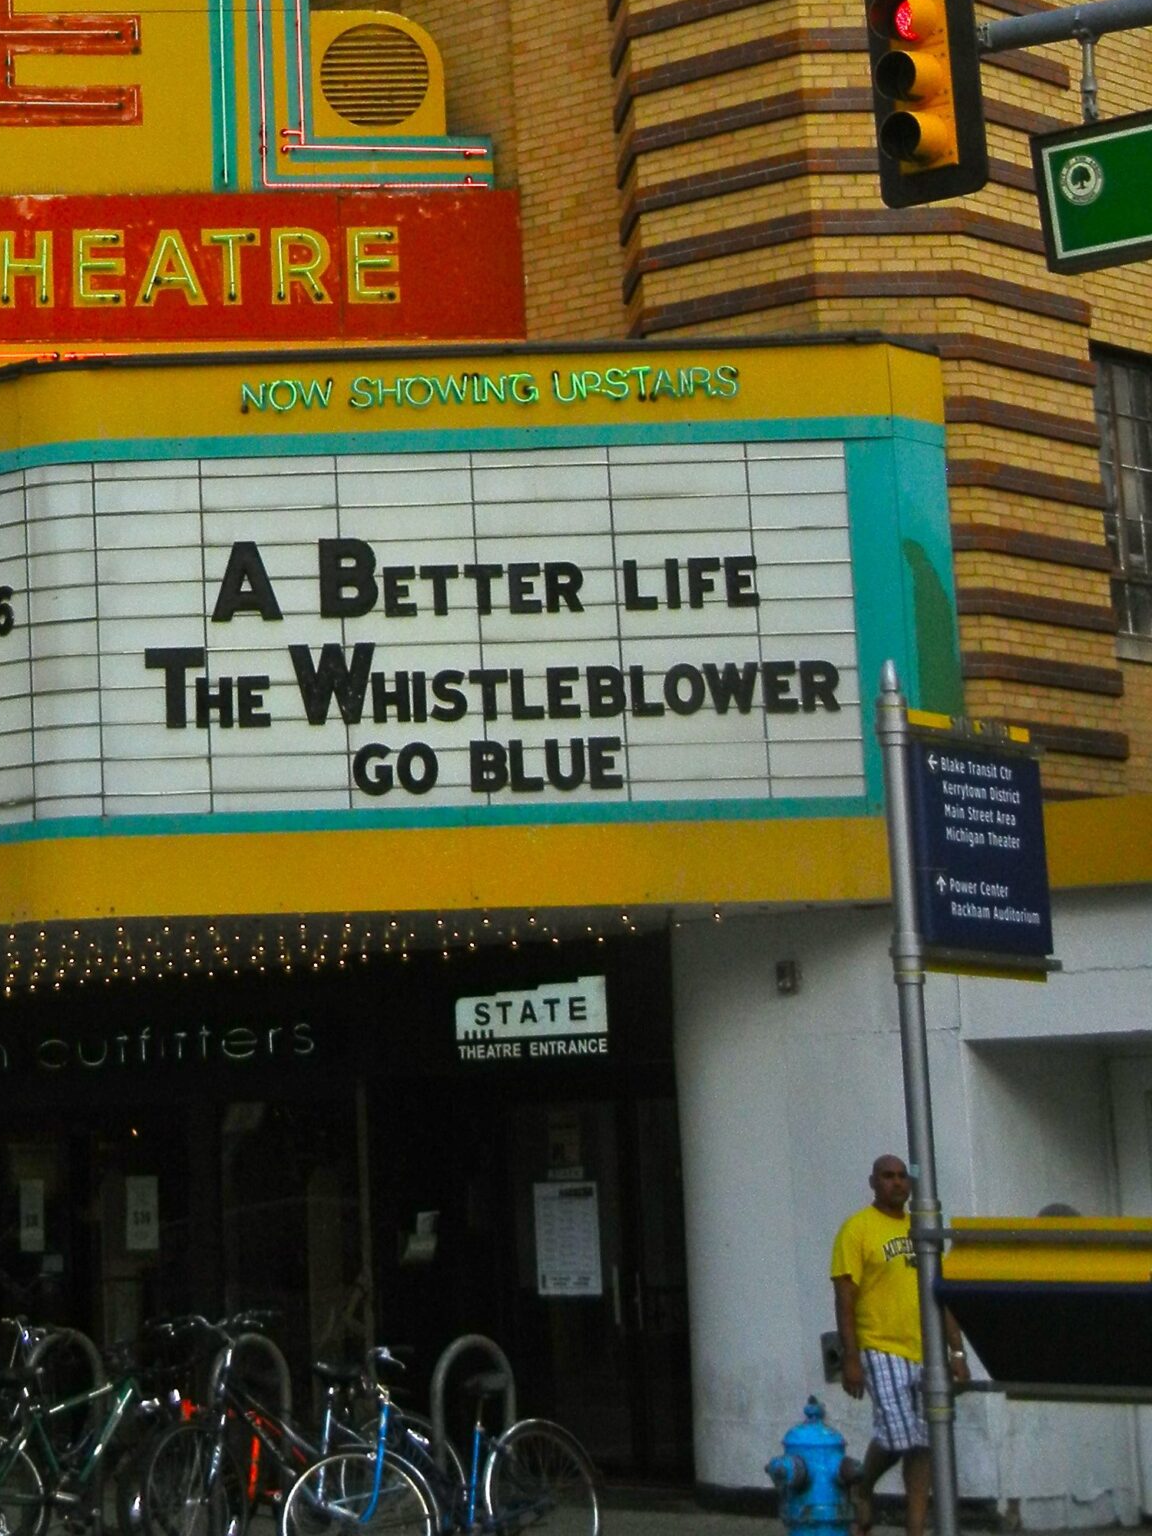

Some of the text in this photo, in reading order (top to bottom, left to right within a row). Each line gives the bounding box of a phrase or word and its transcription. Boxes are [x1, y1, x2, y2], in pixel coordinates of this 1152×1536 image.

[241, 365, 741, 415] NOW SHOWING UPSTAIRS
[211, 537, 761, 623] A BETTER LIFE
[144, 642, 841, 730] THE WHISTLEBLOWER
[352, 736, 625, 796] GO BLUE
[940, 756, 1013, 781] Blake Transit Ctr
[942, 780, 1021, 804] Kerrytown District
[944, 803, 1016, 826] Main Street Area
[946, 826, 1020, 849] Michigan Theater
[949, 877, 1009, 898] Power Center
[950, 901, 1041, 924] Rackham Auditorium
[474, 996, 587, 1026] STATE
[37, 1022, 315, 1071] outfitters
[458, 1038, 608, 1060] THEATRE ENTRANCE
